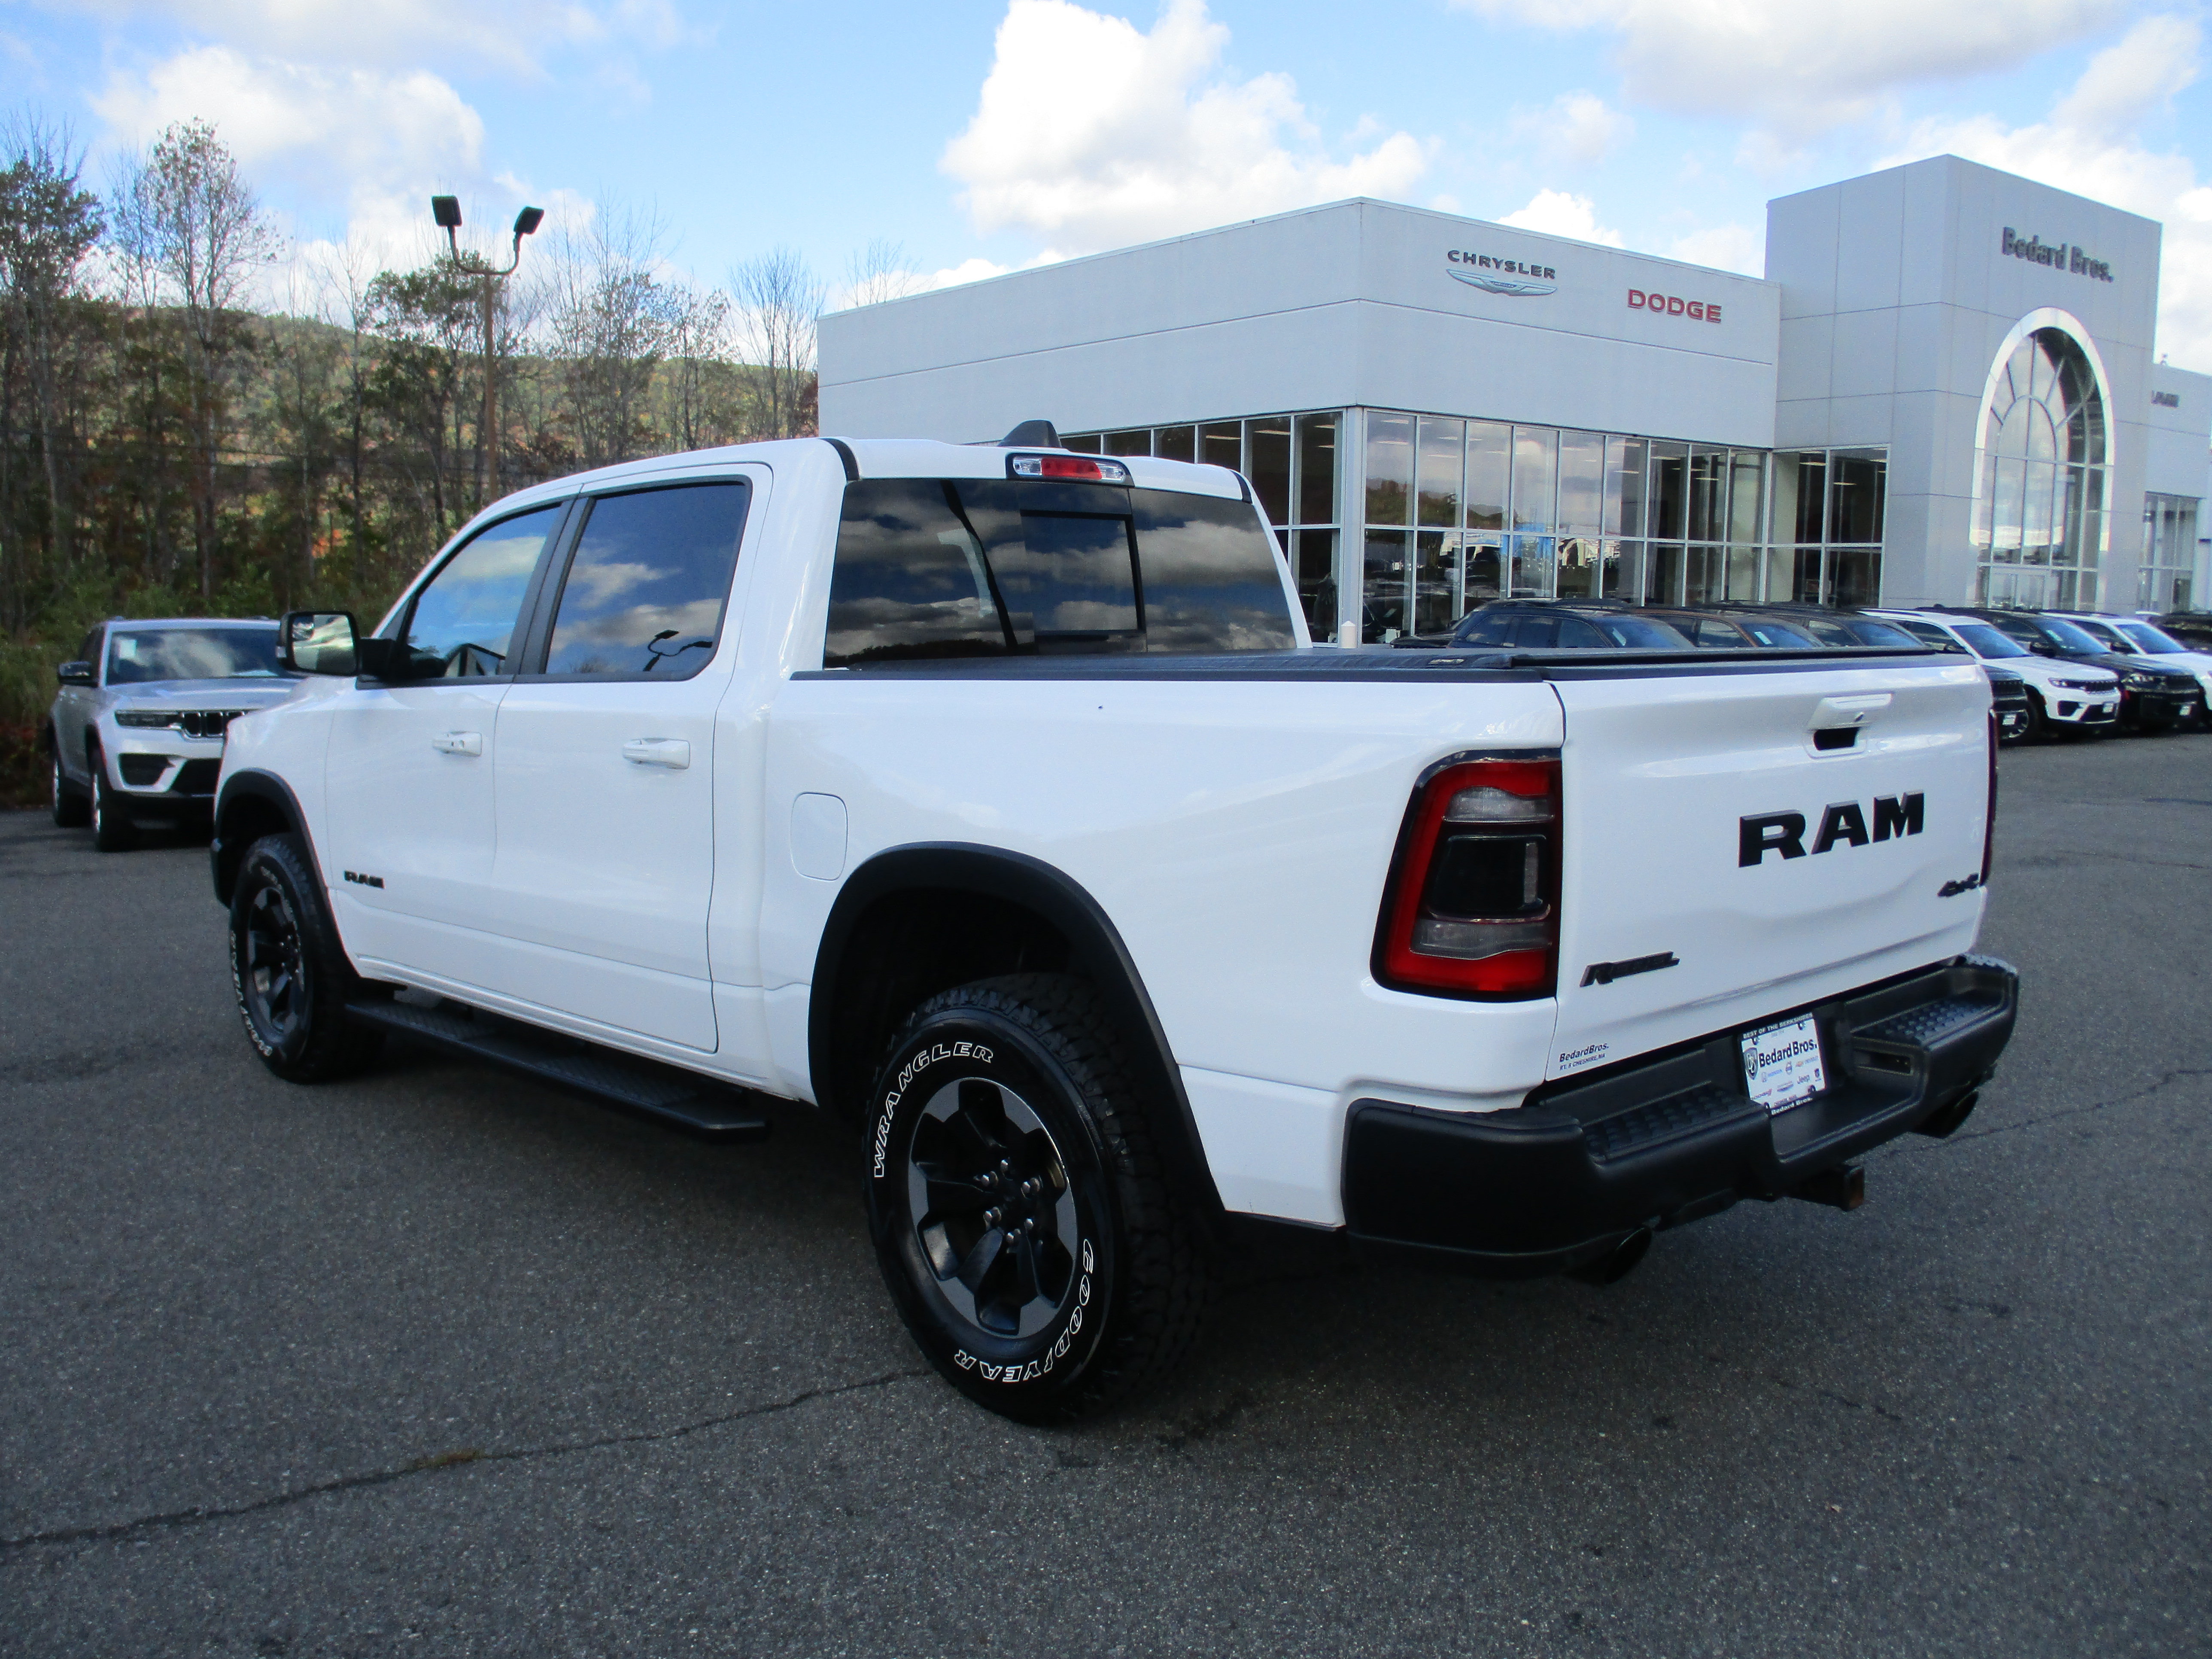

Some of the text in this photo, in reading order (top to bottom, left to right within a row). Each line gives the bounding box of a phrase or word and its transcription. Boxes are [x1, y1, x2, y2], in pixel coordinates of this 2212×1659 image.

[1447, 249, 1556, 280] CHRYSLER
[2002, 226, 2114, 283] Bedard Bros.
[1627, 289, 1723, 323] DODGE
[1738, 790, 1924, 868] RAM
[344, 870, 385, 889] RAM
[873, 1042, 994, 1178] WRANGLER
[954, 1238, 1094, 1383] GOODYEAR
